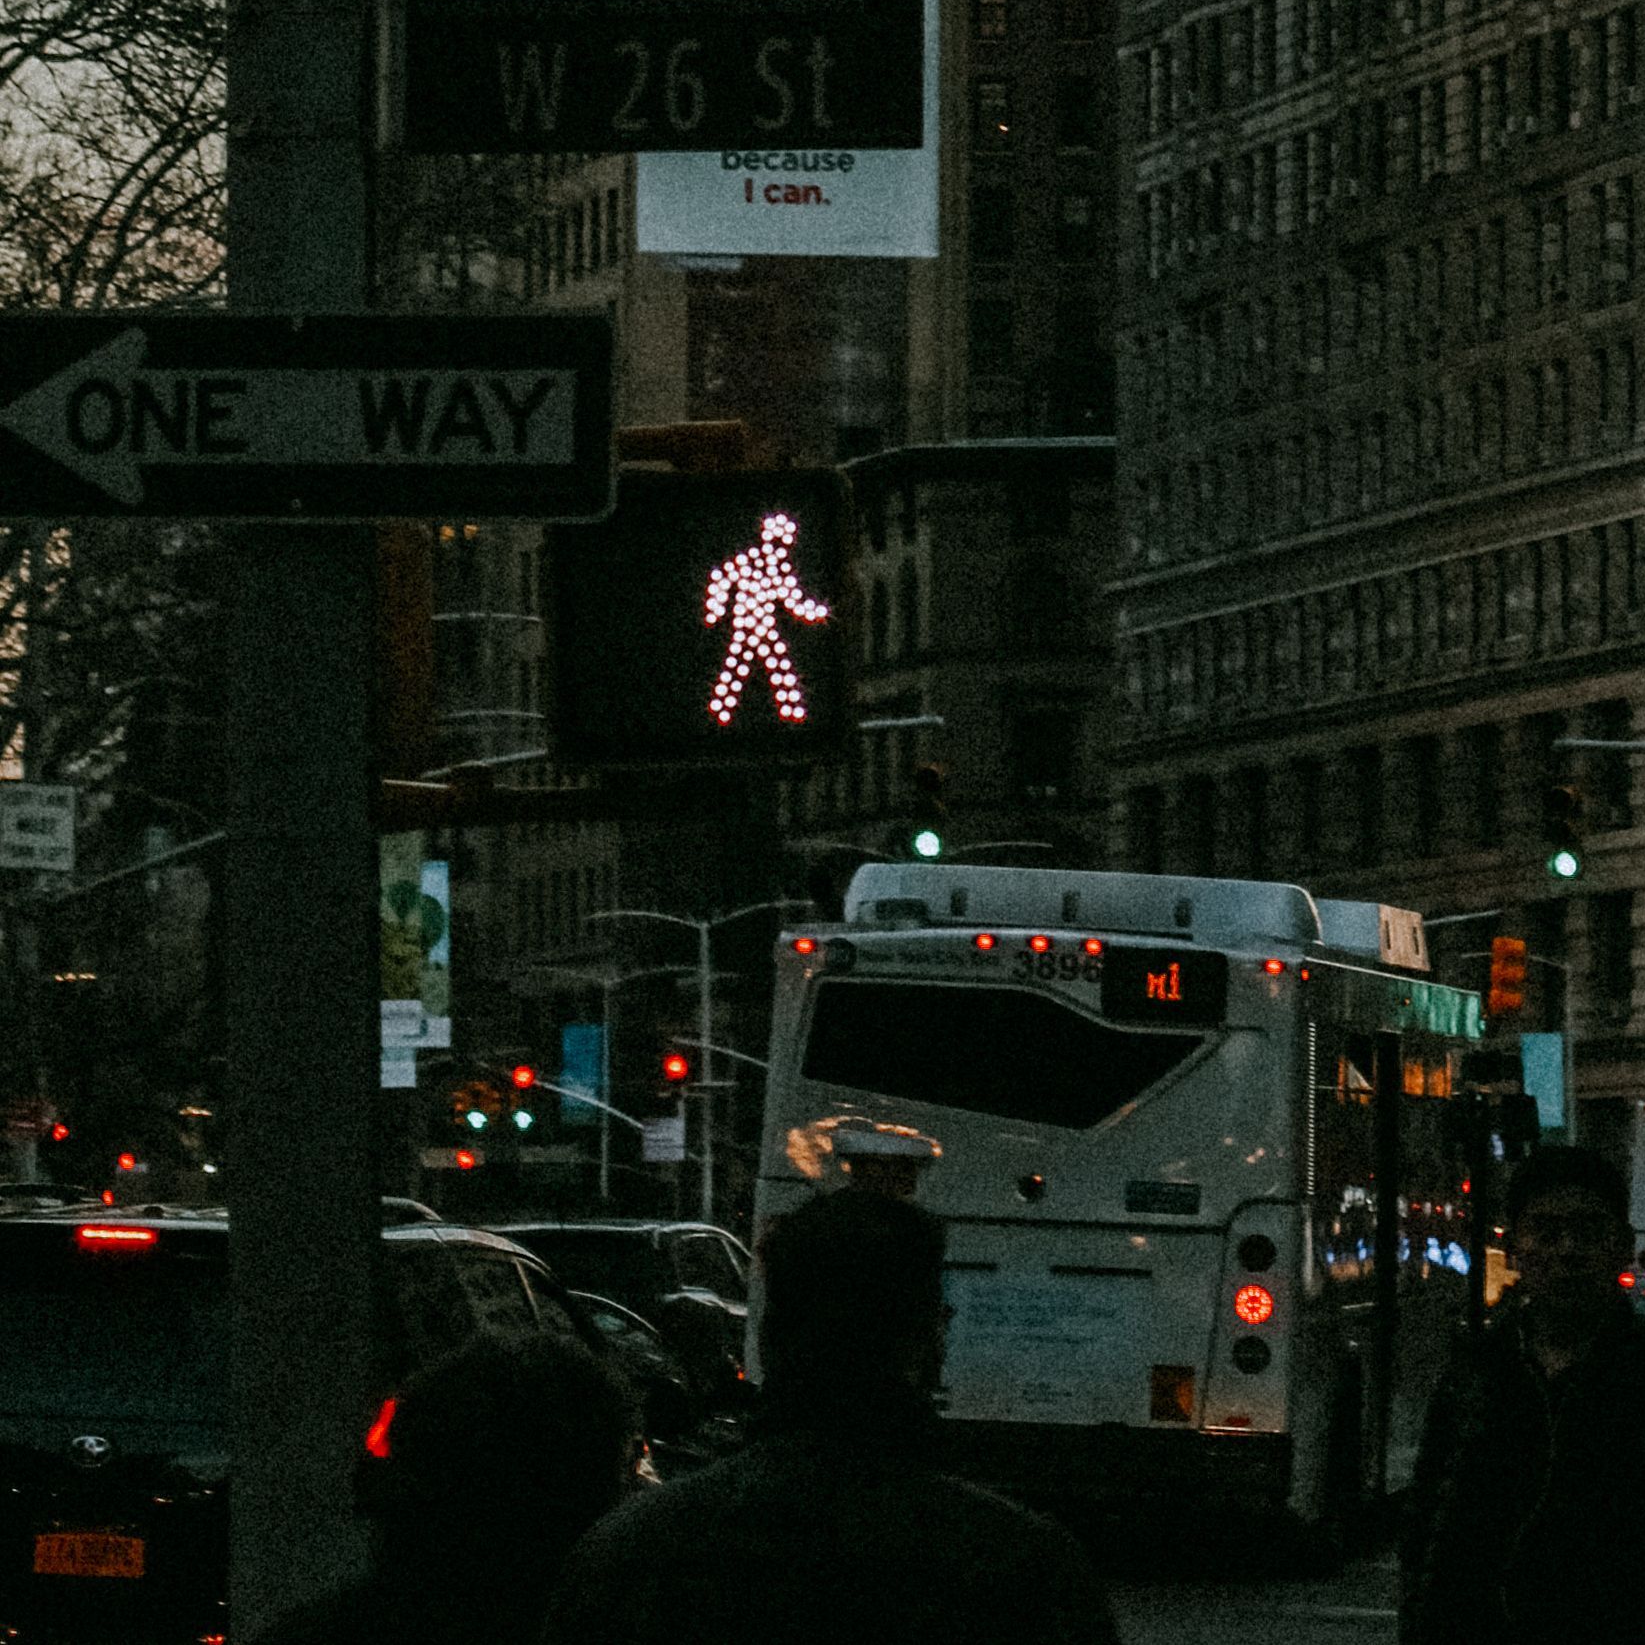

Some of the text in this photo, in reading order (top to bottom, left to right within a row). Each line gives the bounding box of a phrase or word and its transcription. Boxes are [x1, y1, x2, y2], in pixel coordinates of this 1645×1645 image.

[497, 34, 836, 132] W 26 St
[721, 149, 855, 172] because
[744, 179, 831, 205] I can.
[66, 377, 555, 455] ONE WAY
